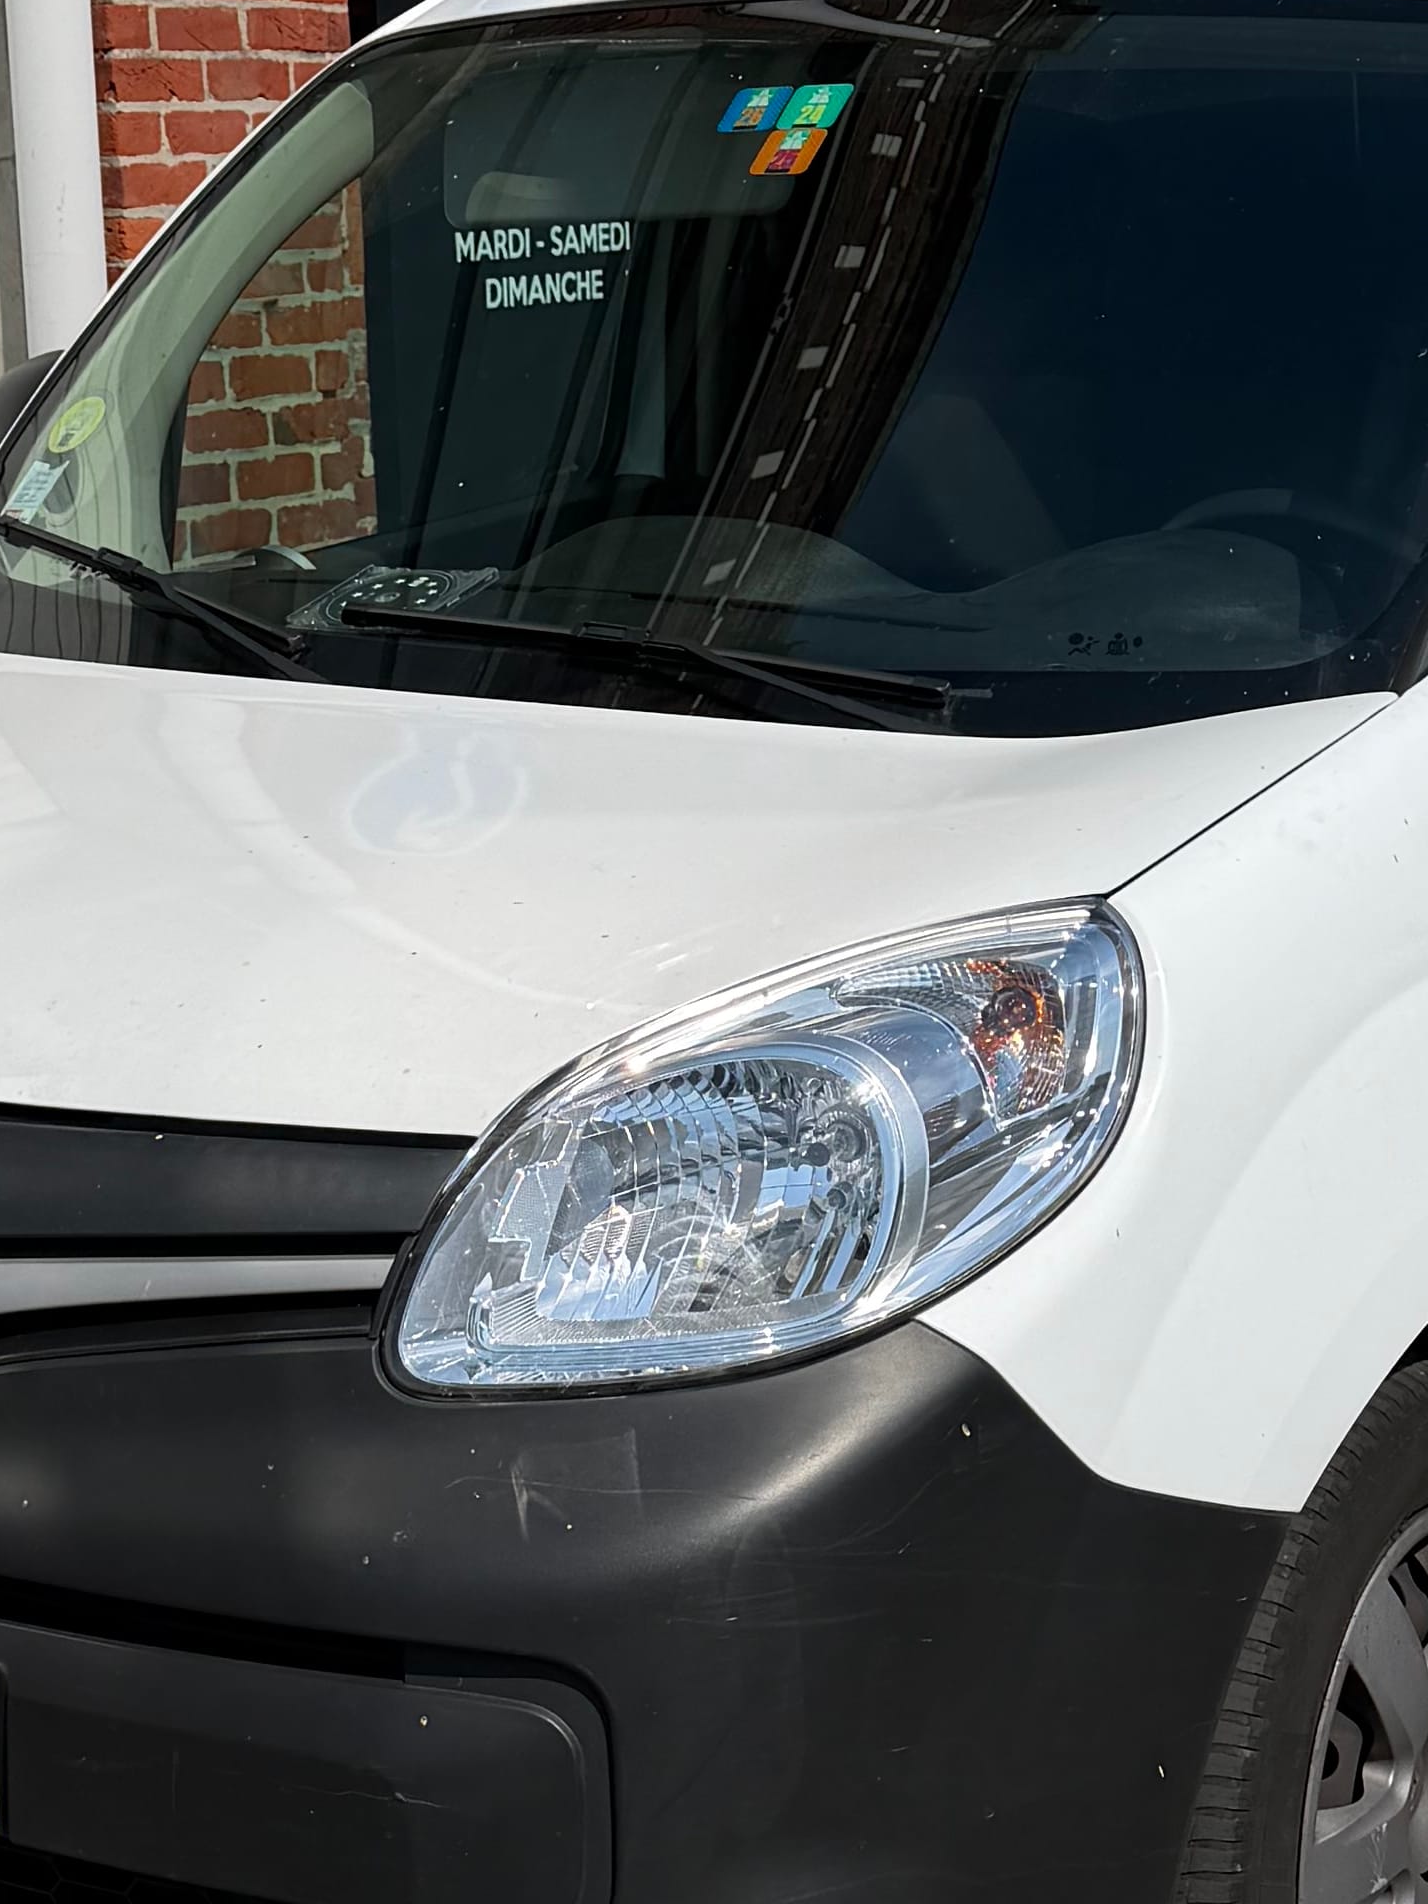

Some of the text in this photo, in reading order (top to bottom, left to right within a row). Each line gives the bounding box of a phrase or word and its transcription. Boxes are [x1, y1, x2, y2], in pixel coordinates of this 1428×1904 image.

[454, 227, 532, 264] MARDI
[549, 221, 631, 257] SAMEDI
[485, 269, 605, 310] DIMANCHE
